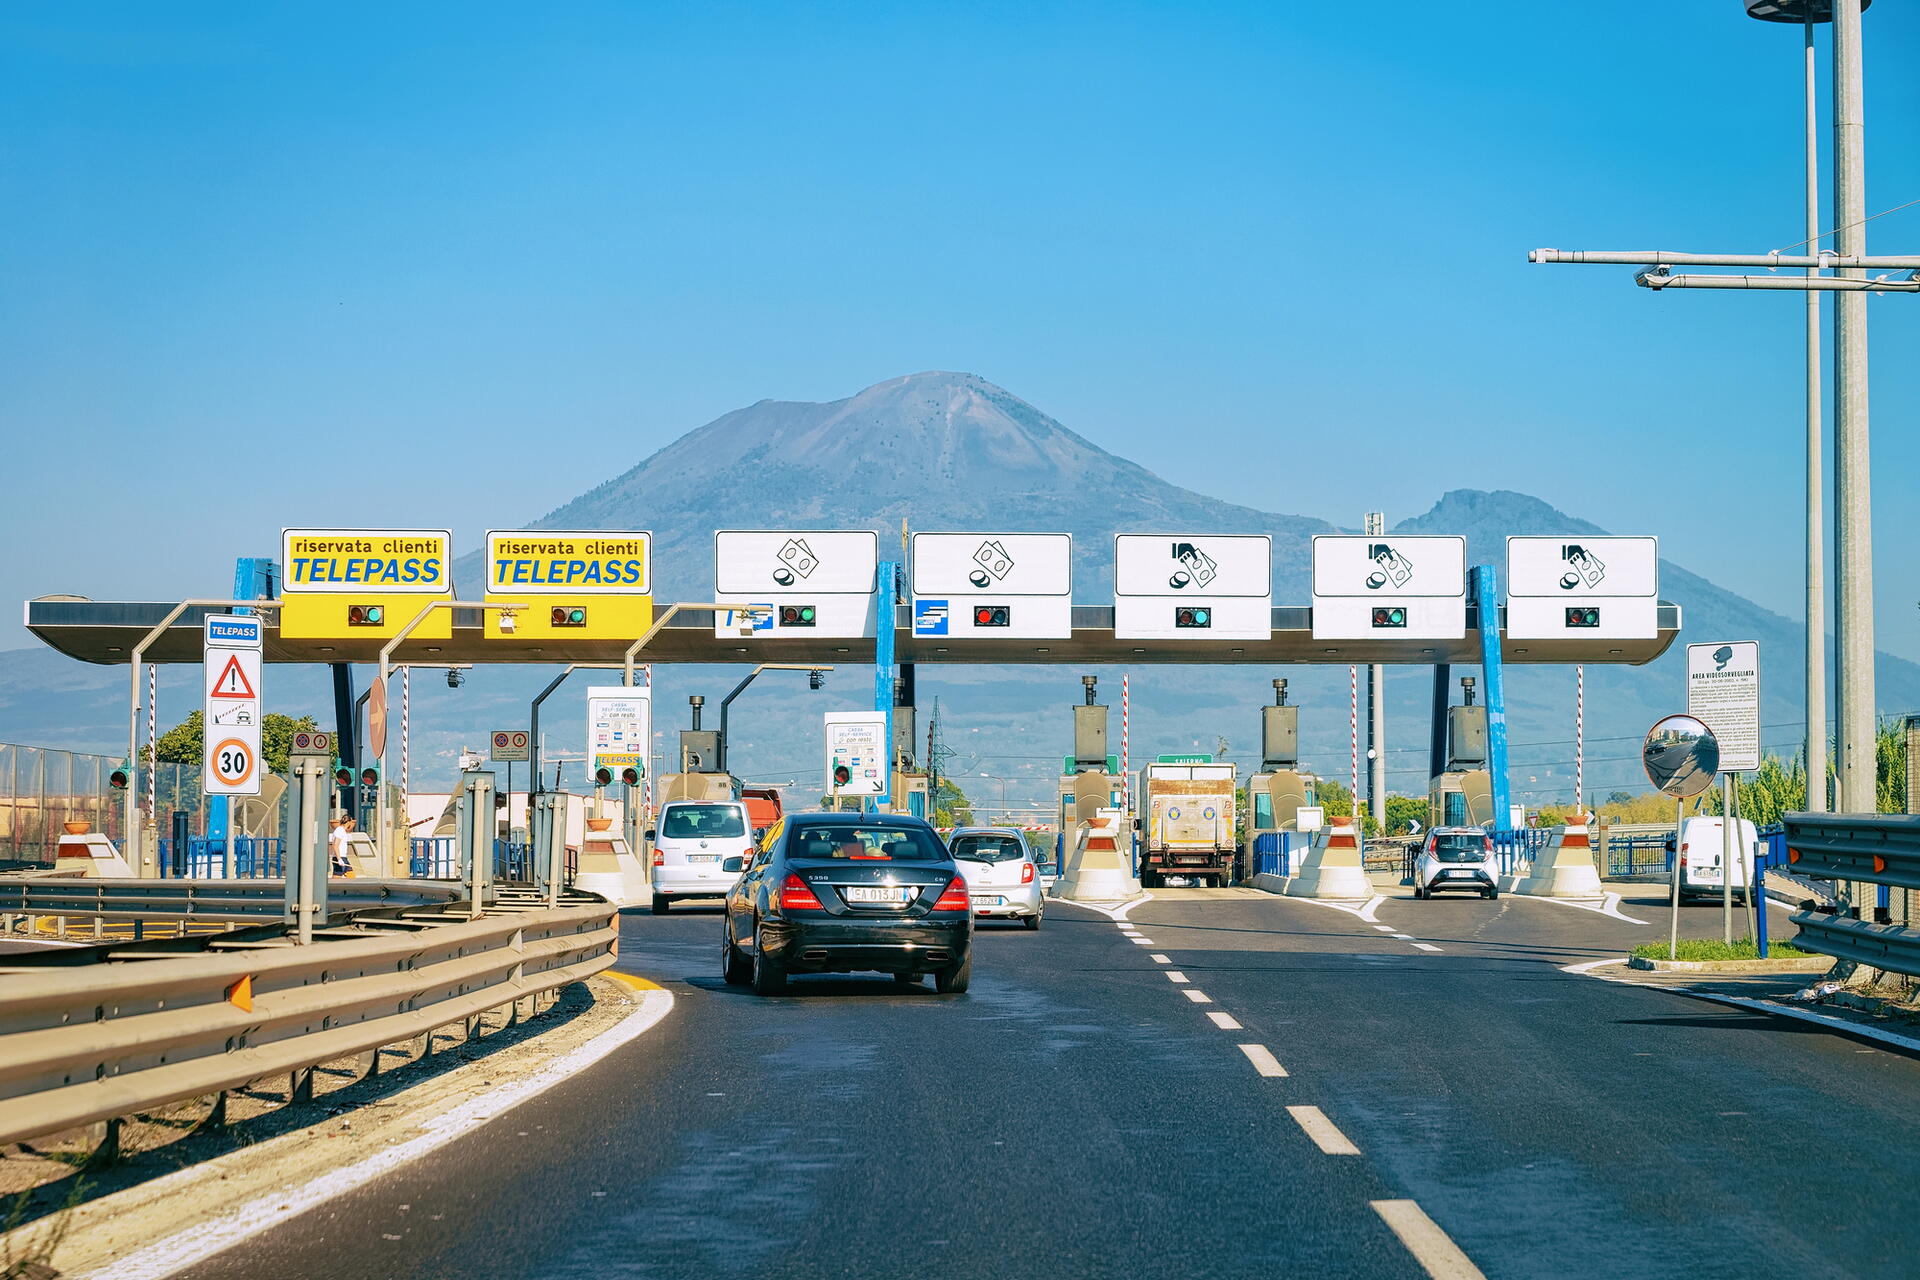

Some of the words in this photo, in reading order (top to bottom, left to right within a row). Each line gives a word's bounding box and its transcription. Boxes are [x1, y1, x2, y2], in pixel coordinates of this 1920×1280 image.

[296, 539, 372, 553] riservata
[383, 540, 437, 553] clienti
[500, 541, 574, 554] riservata
[585, 542, 638, 555] clienti
[293, 558, 440, 582] TELEPASS
[496, 560, 641, 584] TELEPASS
[212, 626, 256, 637] TELEPASS
[221, 752, 245, 773] 30
[855, 889, 867, 900] EA
